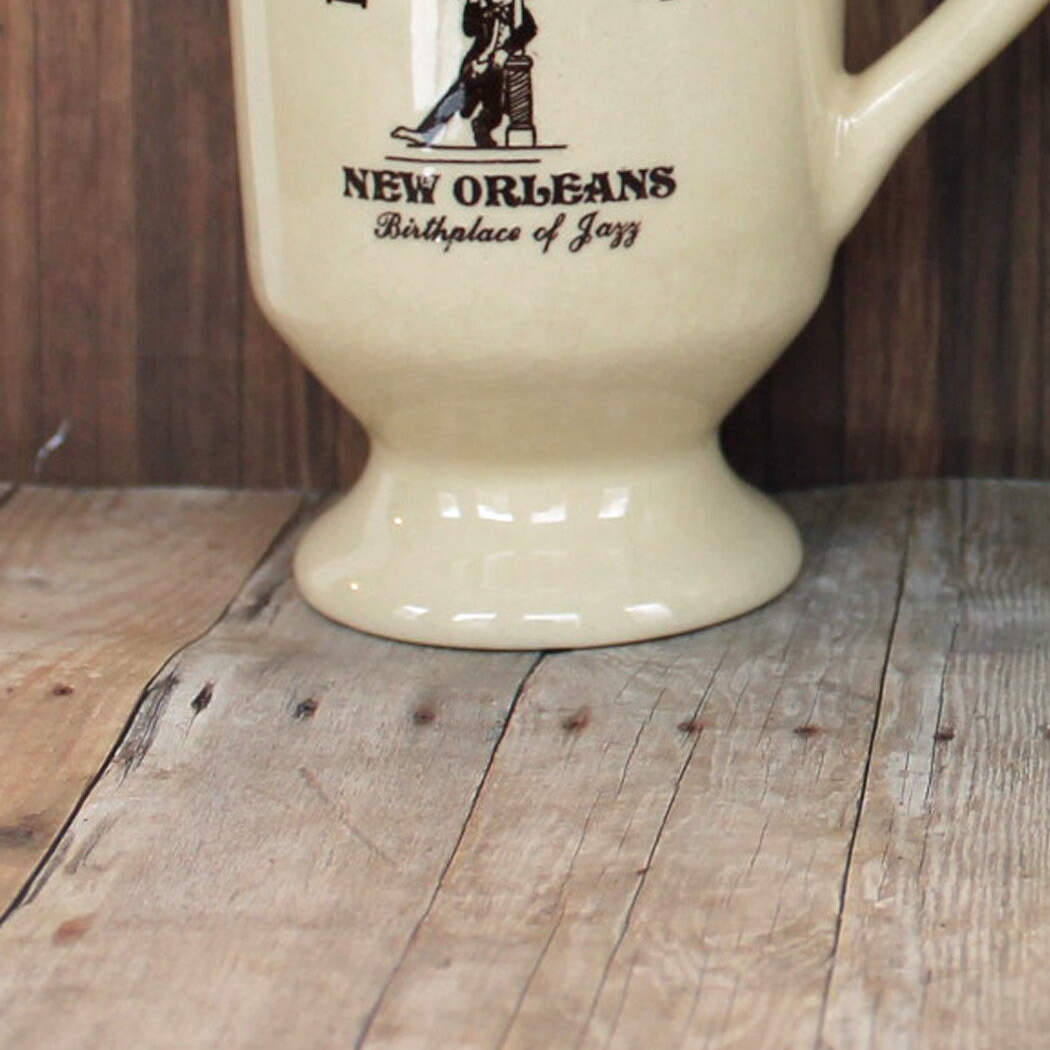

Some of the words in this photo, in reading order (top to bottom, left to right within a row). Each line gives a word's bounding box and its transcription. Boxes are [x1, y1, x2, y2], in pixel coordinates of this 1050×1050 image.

[342, 165, 439, 205] NEW
[453, 166, 677, 207] ORLEANS
[374, 211, 521, 252] Birthplace
[533, 213, 566, 252] of
[569, 211, 642, 252] Jazz
